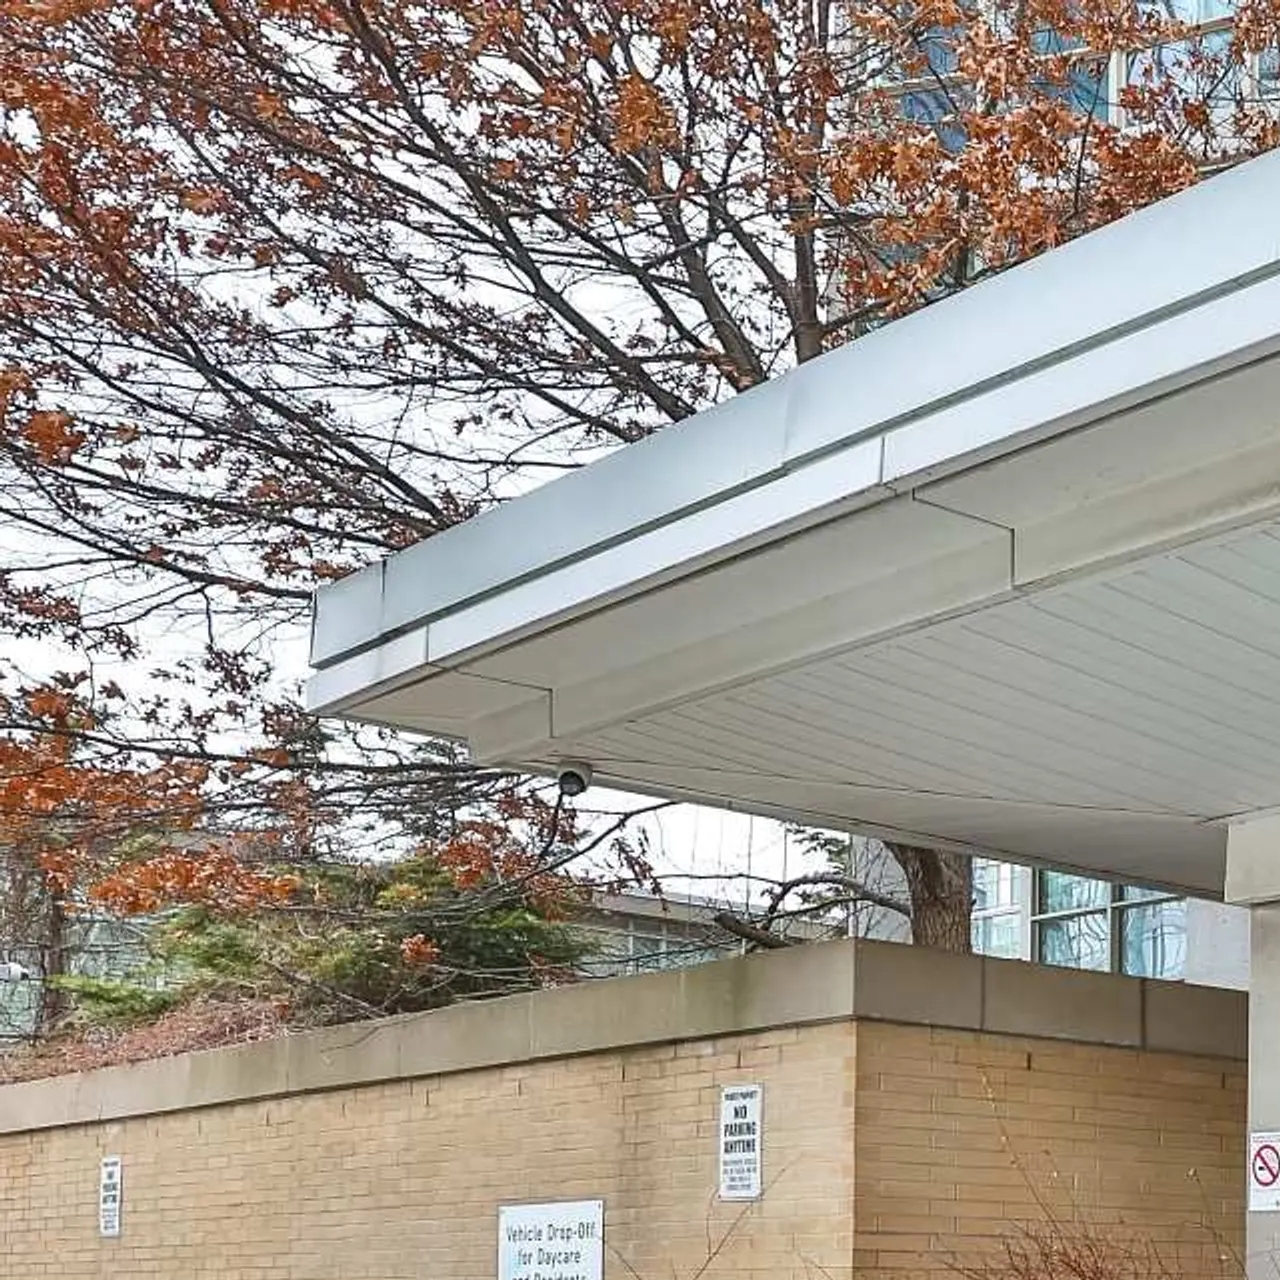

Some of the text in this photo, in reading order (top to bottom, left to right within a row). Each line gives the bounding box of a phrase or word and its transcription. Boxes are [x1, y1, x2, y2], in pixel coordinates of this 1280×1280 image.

[733, 1105, 748, 1119] NO
[723, 1122, 756, 1137] PARKING
[506, 1221, 596, 1242] Vehicle Drop-Off
[517, 1248, 582, 1268] for Daycare
